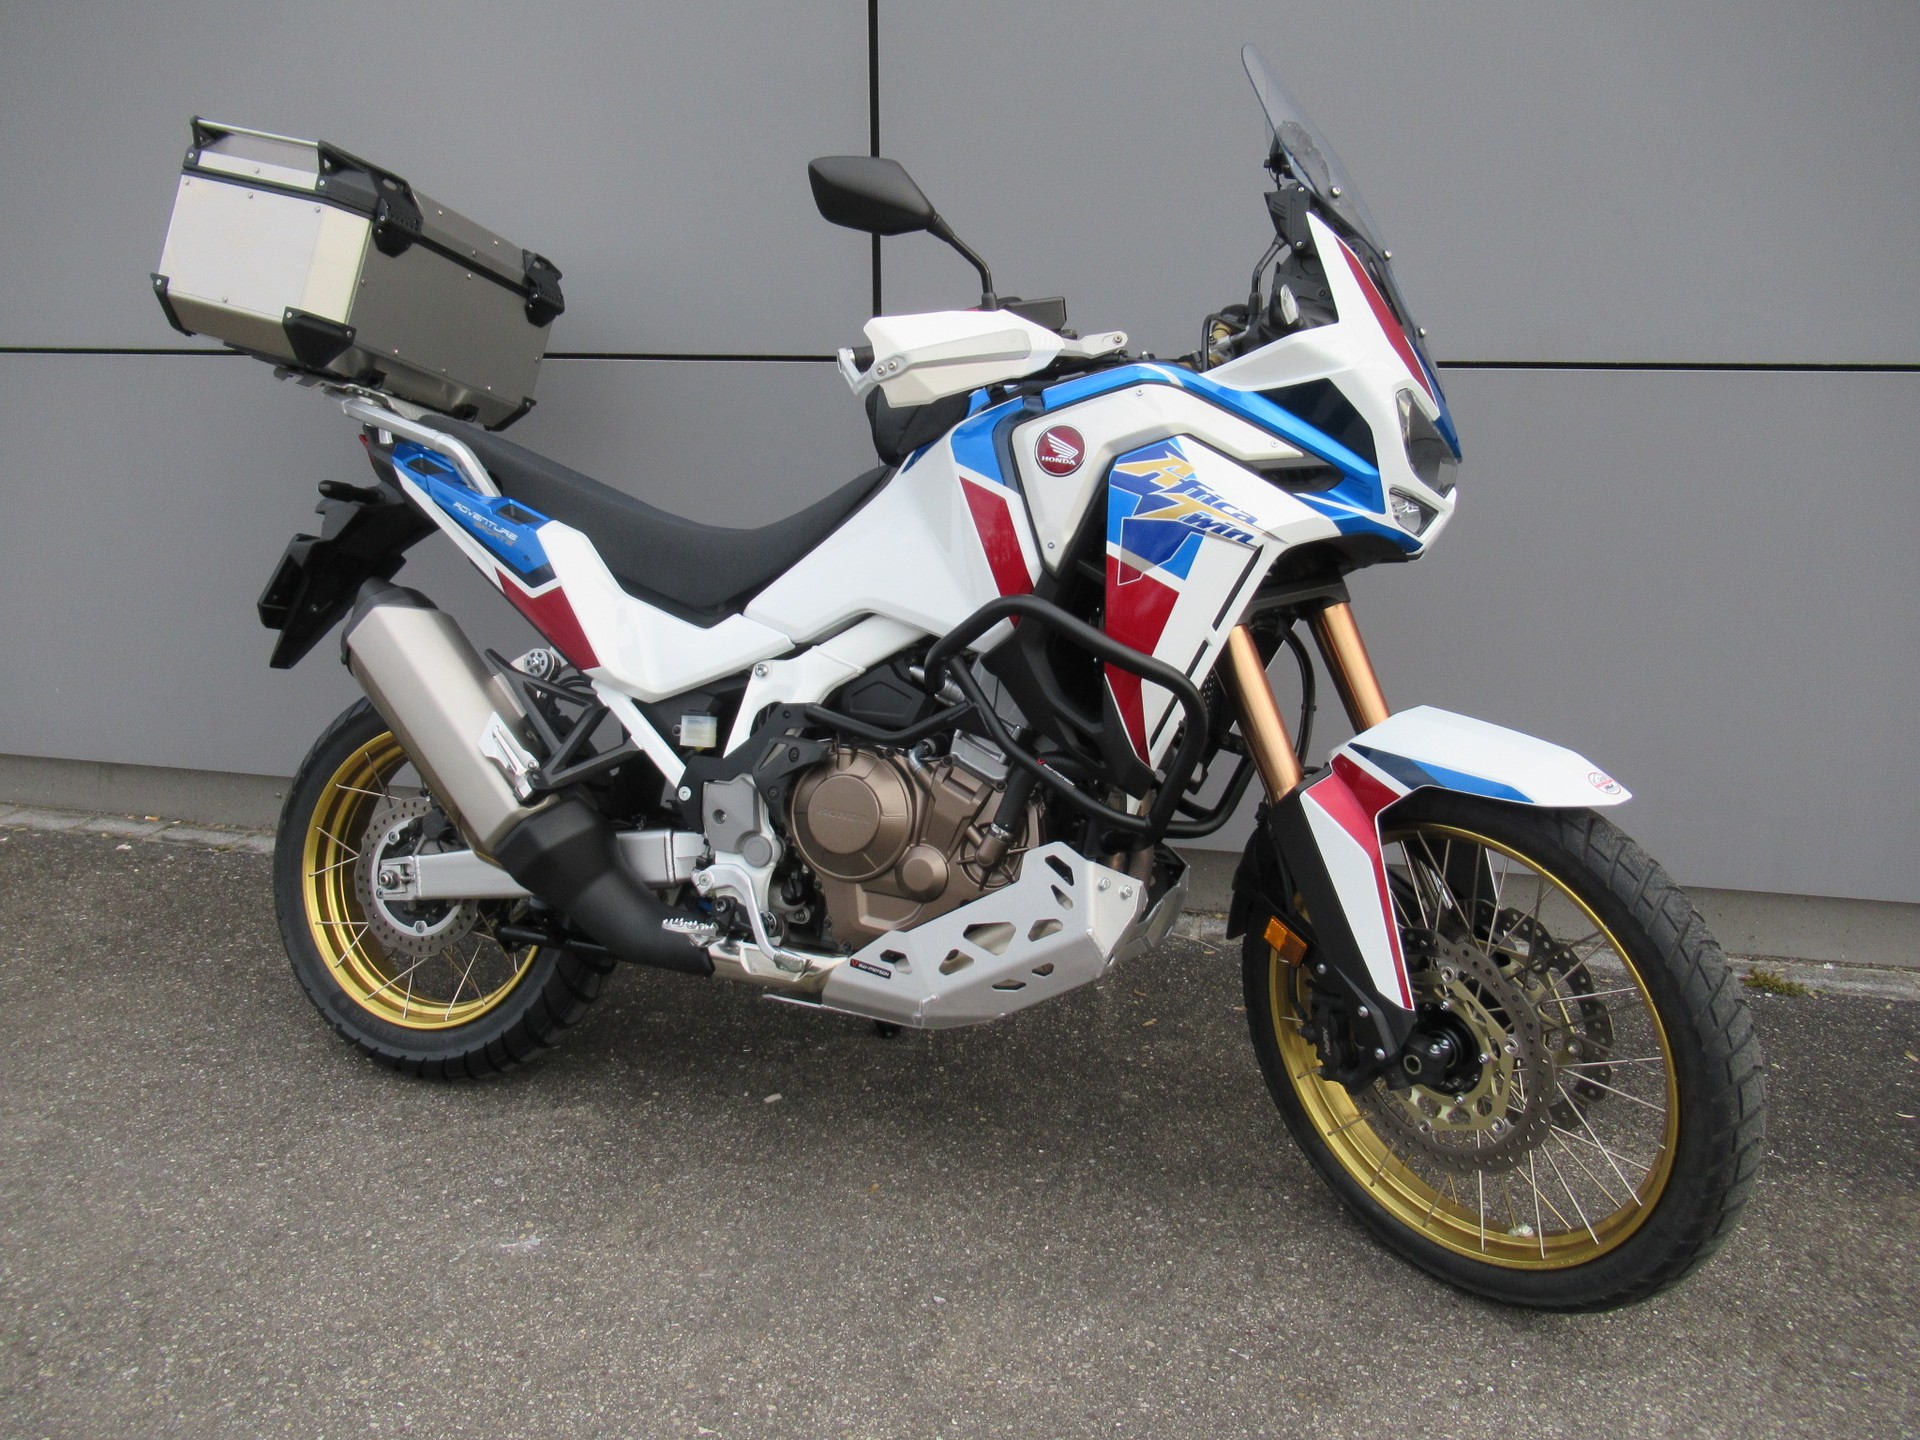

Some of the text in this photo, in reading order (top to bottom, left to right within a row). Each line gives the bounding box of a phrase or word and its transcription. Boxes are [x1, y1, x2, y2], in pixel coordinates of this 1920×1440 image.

[1041, 456, 1076, 466] HONDA
[1116, 452, 1258, 526] Africa
[453, 501, 518, 541] ADVENTURE
[1134, 494, 1257, 546] Twin
[816, 804, 872, 826] HONDA
